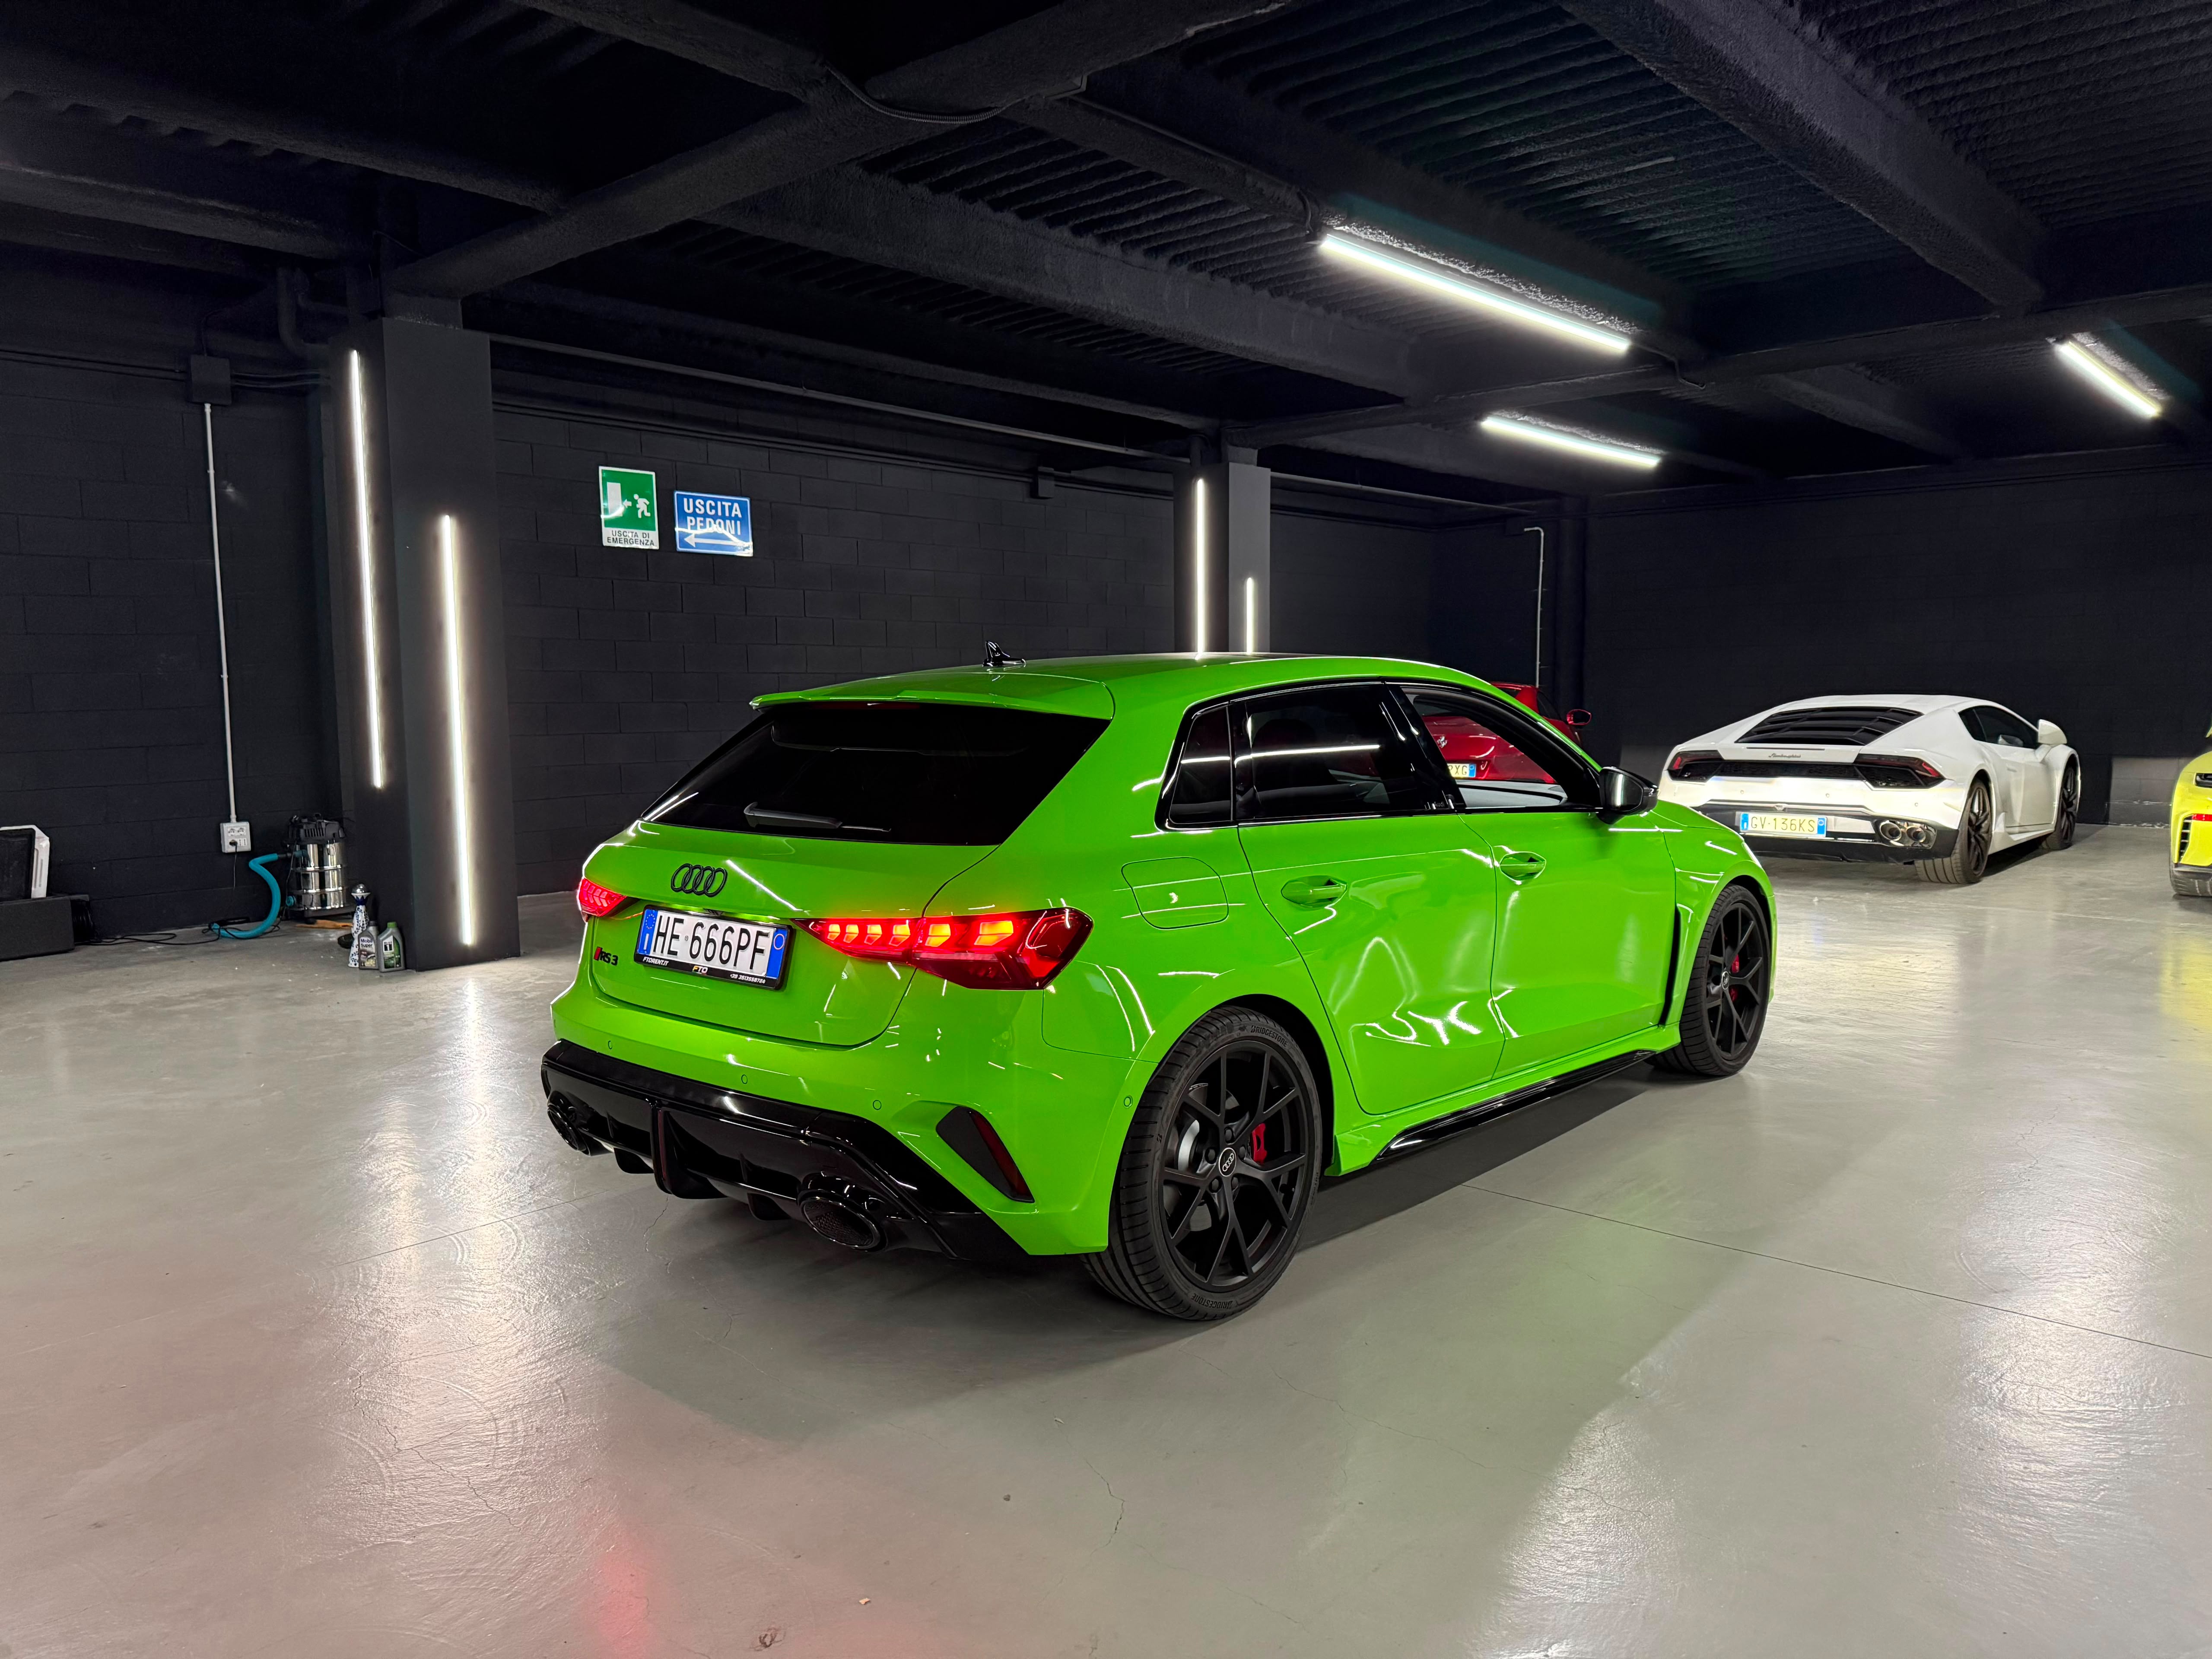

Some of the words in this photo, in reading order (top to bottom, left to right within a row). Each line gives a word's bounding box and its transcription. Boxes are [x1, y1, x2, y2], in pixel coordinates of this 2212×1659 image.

[683, 498, 742, 518] USCITA
[686, 516, 741, 535] PEDONI
[607, 537, 655, 546] EMERGENZA
[1773, 818, 1815, 832] 136KS
[652, 915, 684, 956] HE
[689, 920, 770, 970] 666PF
[642, 957, 669, 966] FTORENT.IT
[692, 965, 709, 974] FTO
[1250, 1025, 1288, 1047] BRIDGESTONE
